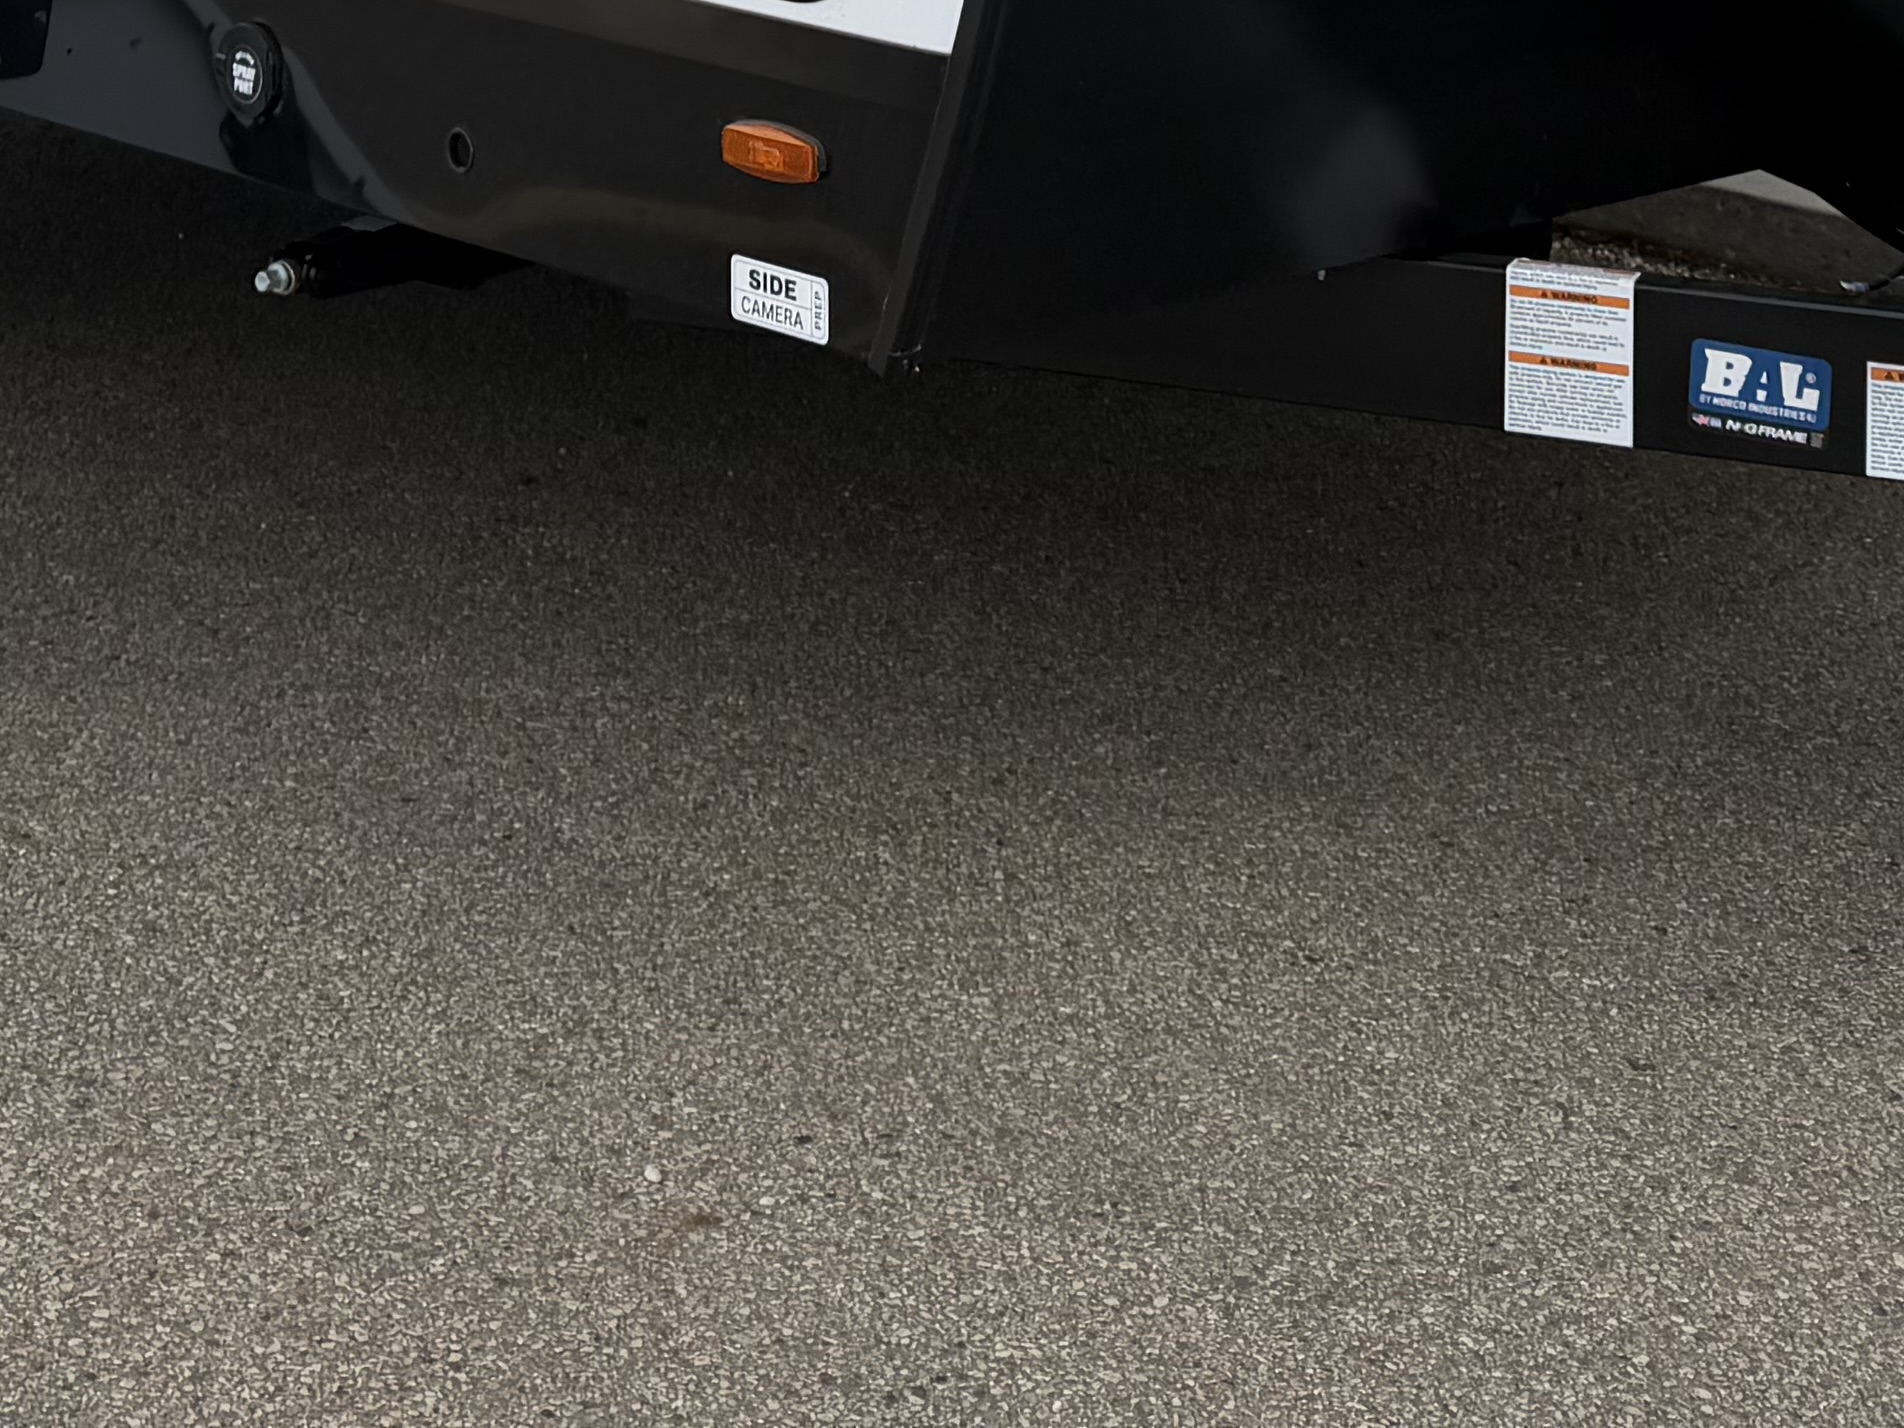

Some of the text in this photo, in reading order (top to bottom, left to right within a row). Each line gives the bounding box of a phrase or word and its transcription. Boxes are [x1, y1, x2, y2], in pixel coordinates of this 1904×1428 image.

[748, 268, 798, 302] SIDE
[1550, 291, 1599, 305] WARNING
[741, 295, 804, 331] CAMERA
[814, 290, 825, 331] PREP
[1550, 357, 1598, 372] WARNING
